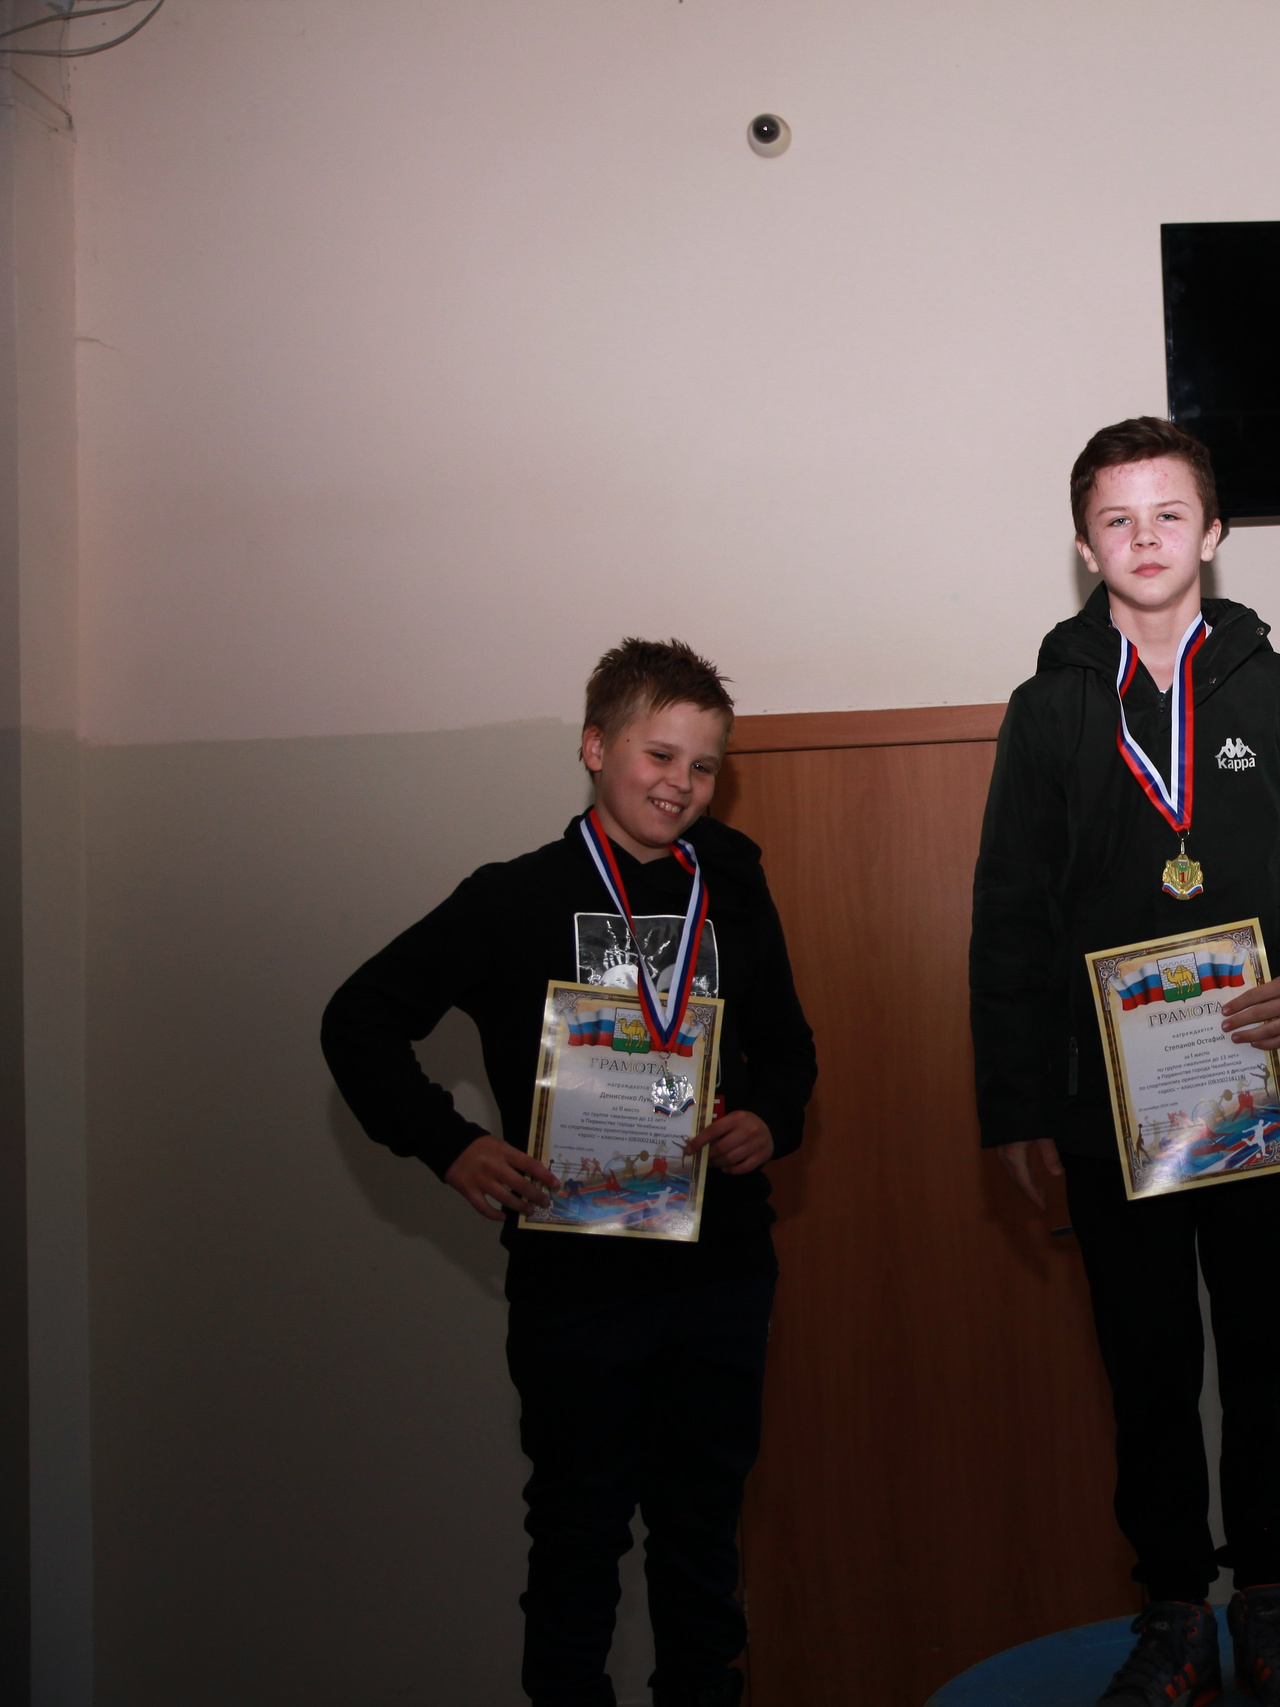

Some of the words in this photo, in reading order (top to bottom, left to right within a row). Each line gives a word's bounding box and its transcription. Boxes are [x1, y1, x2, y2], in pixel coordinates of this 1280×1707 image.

[1217, 757, 1256, 772] Kappa
[1180, 871, 1187, 883] 1
[1149, 1001, 1224, 1027] ГРАМОТА
[1172, 1026, 1214, 1038] награждается
[1164, 1041, 1195, 1052] Степанов
[1196, 1034, 1226, 1046] Остафий
[591, 1057, 667, 1075] ГРАМОТА
[607, 1082, 650, 1091] награждается
[600, 1091, 637, 1102] Денисенко
